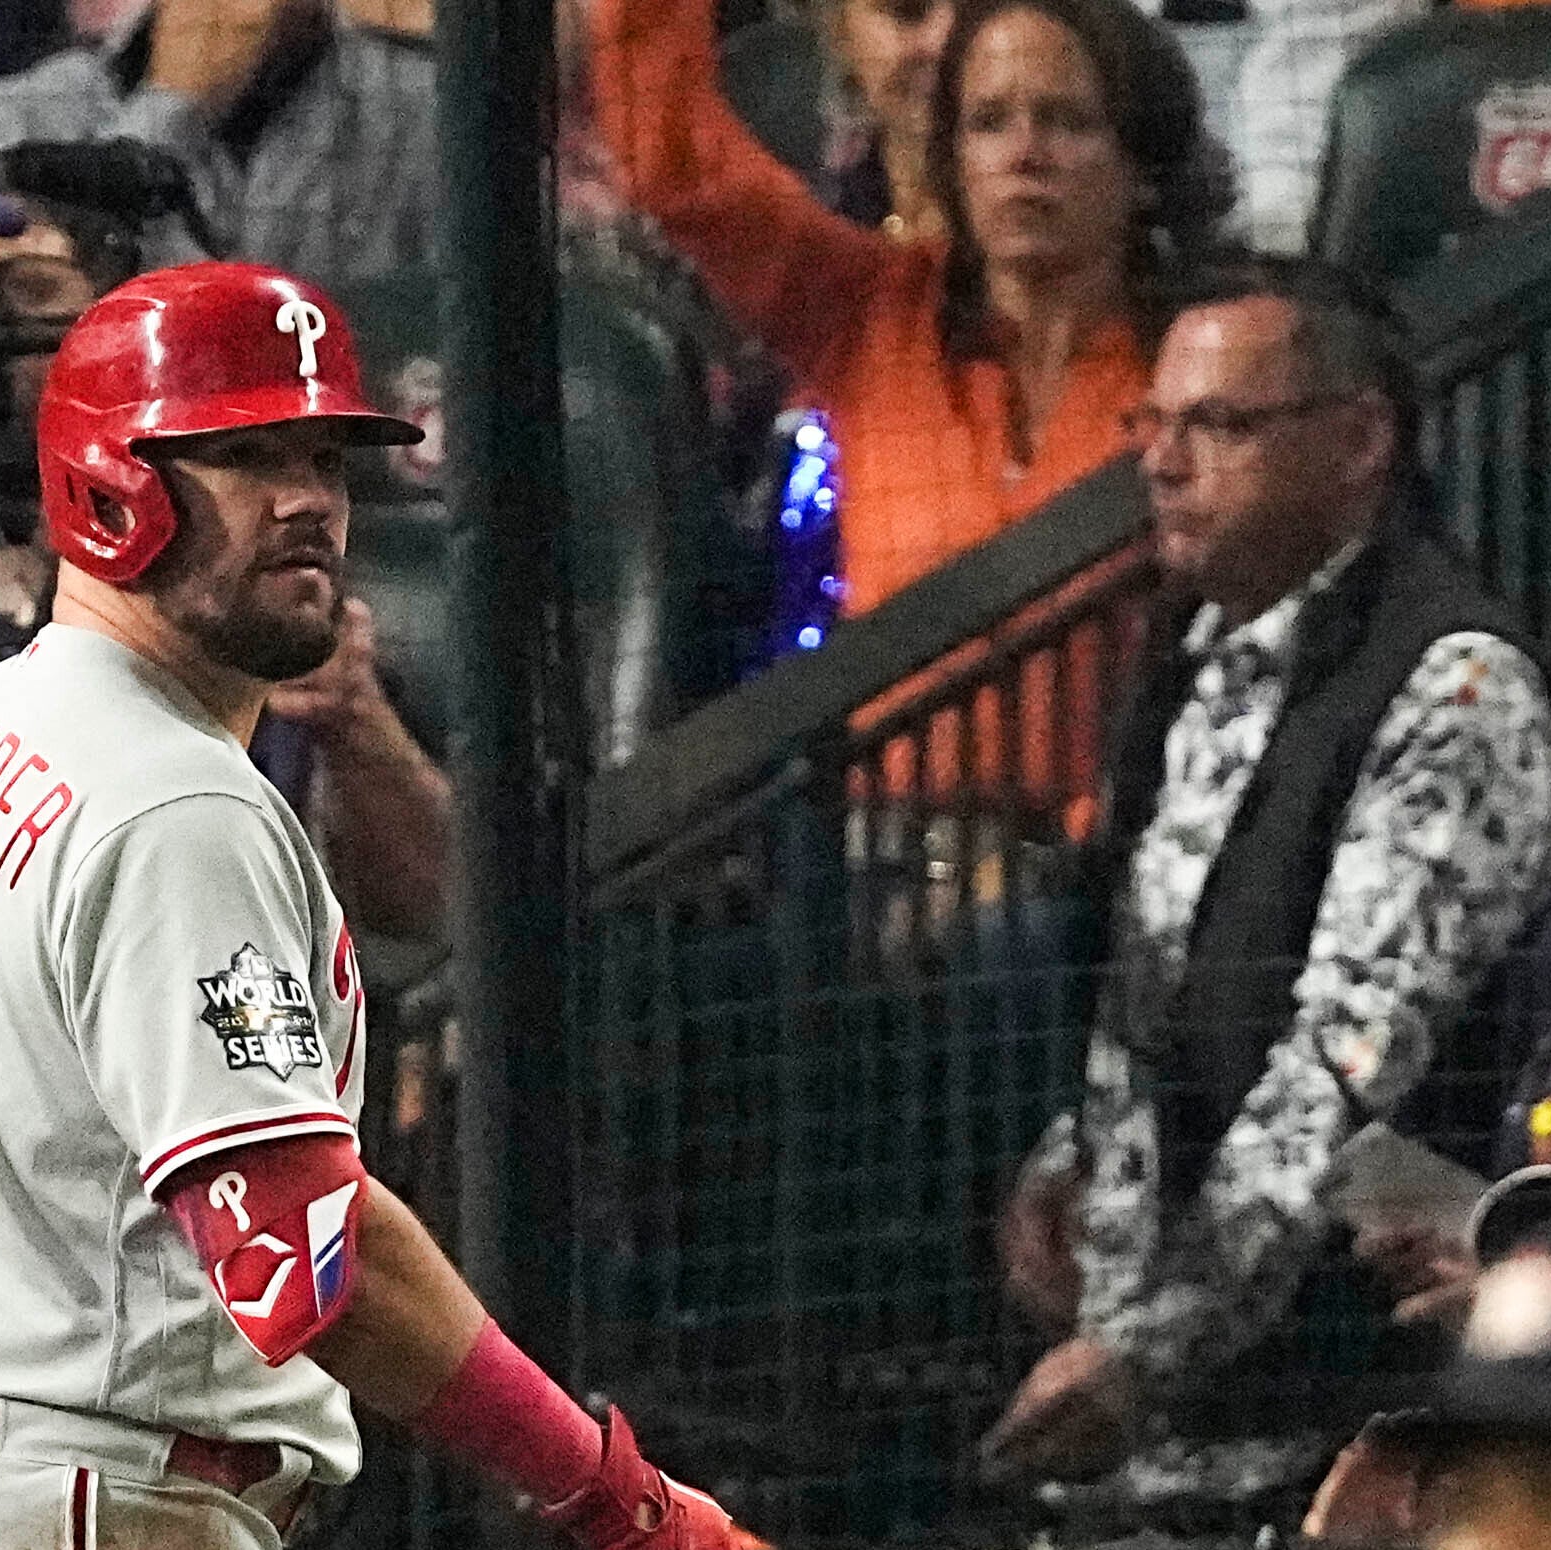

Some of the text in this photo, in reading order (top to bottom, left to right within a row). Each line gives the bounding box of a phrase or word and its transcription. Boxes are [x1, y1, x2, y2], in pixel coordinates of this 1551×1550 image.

[276, 300, 326, 377] P
[202, 977, 308, 1009] WORLD
[209, 1171, 251, 1232] P
